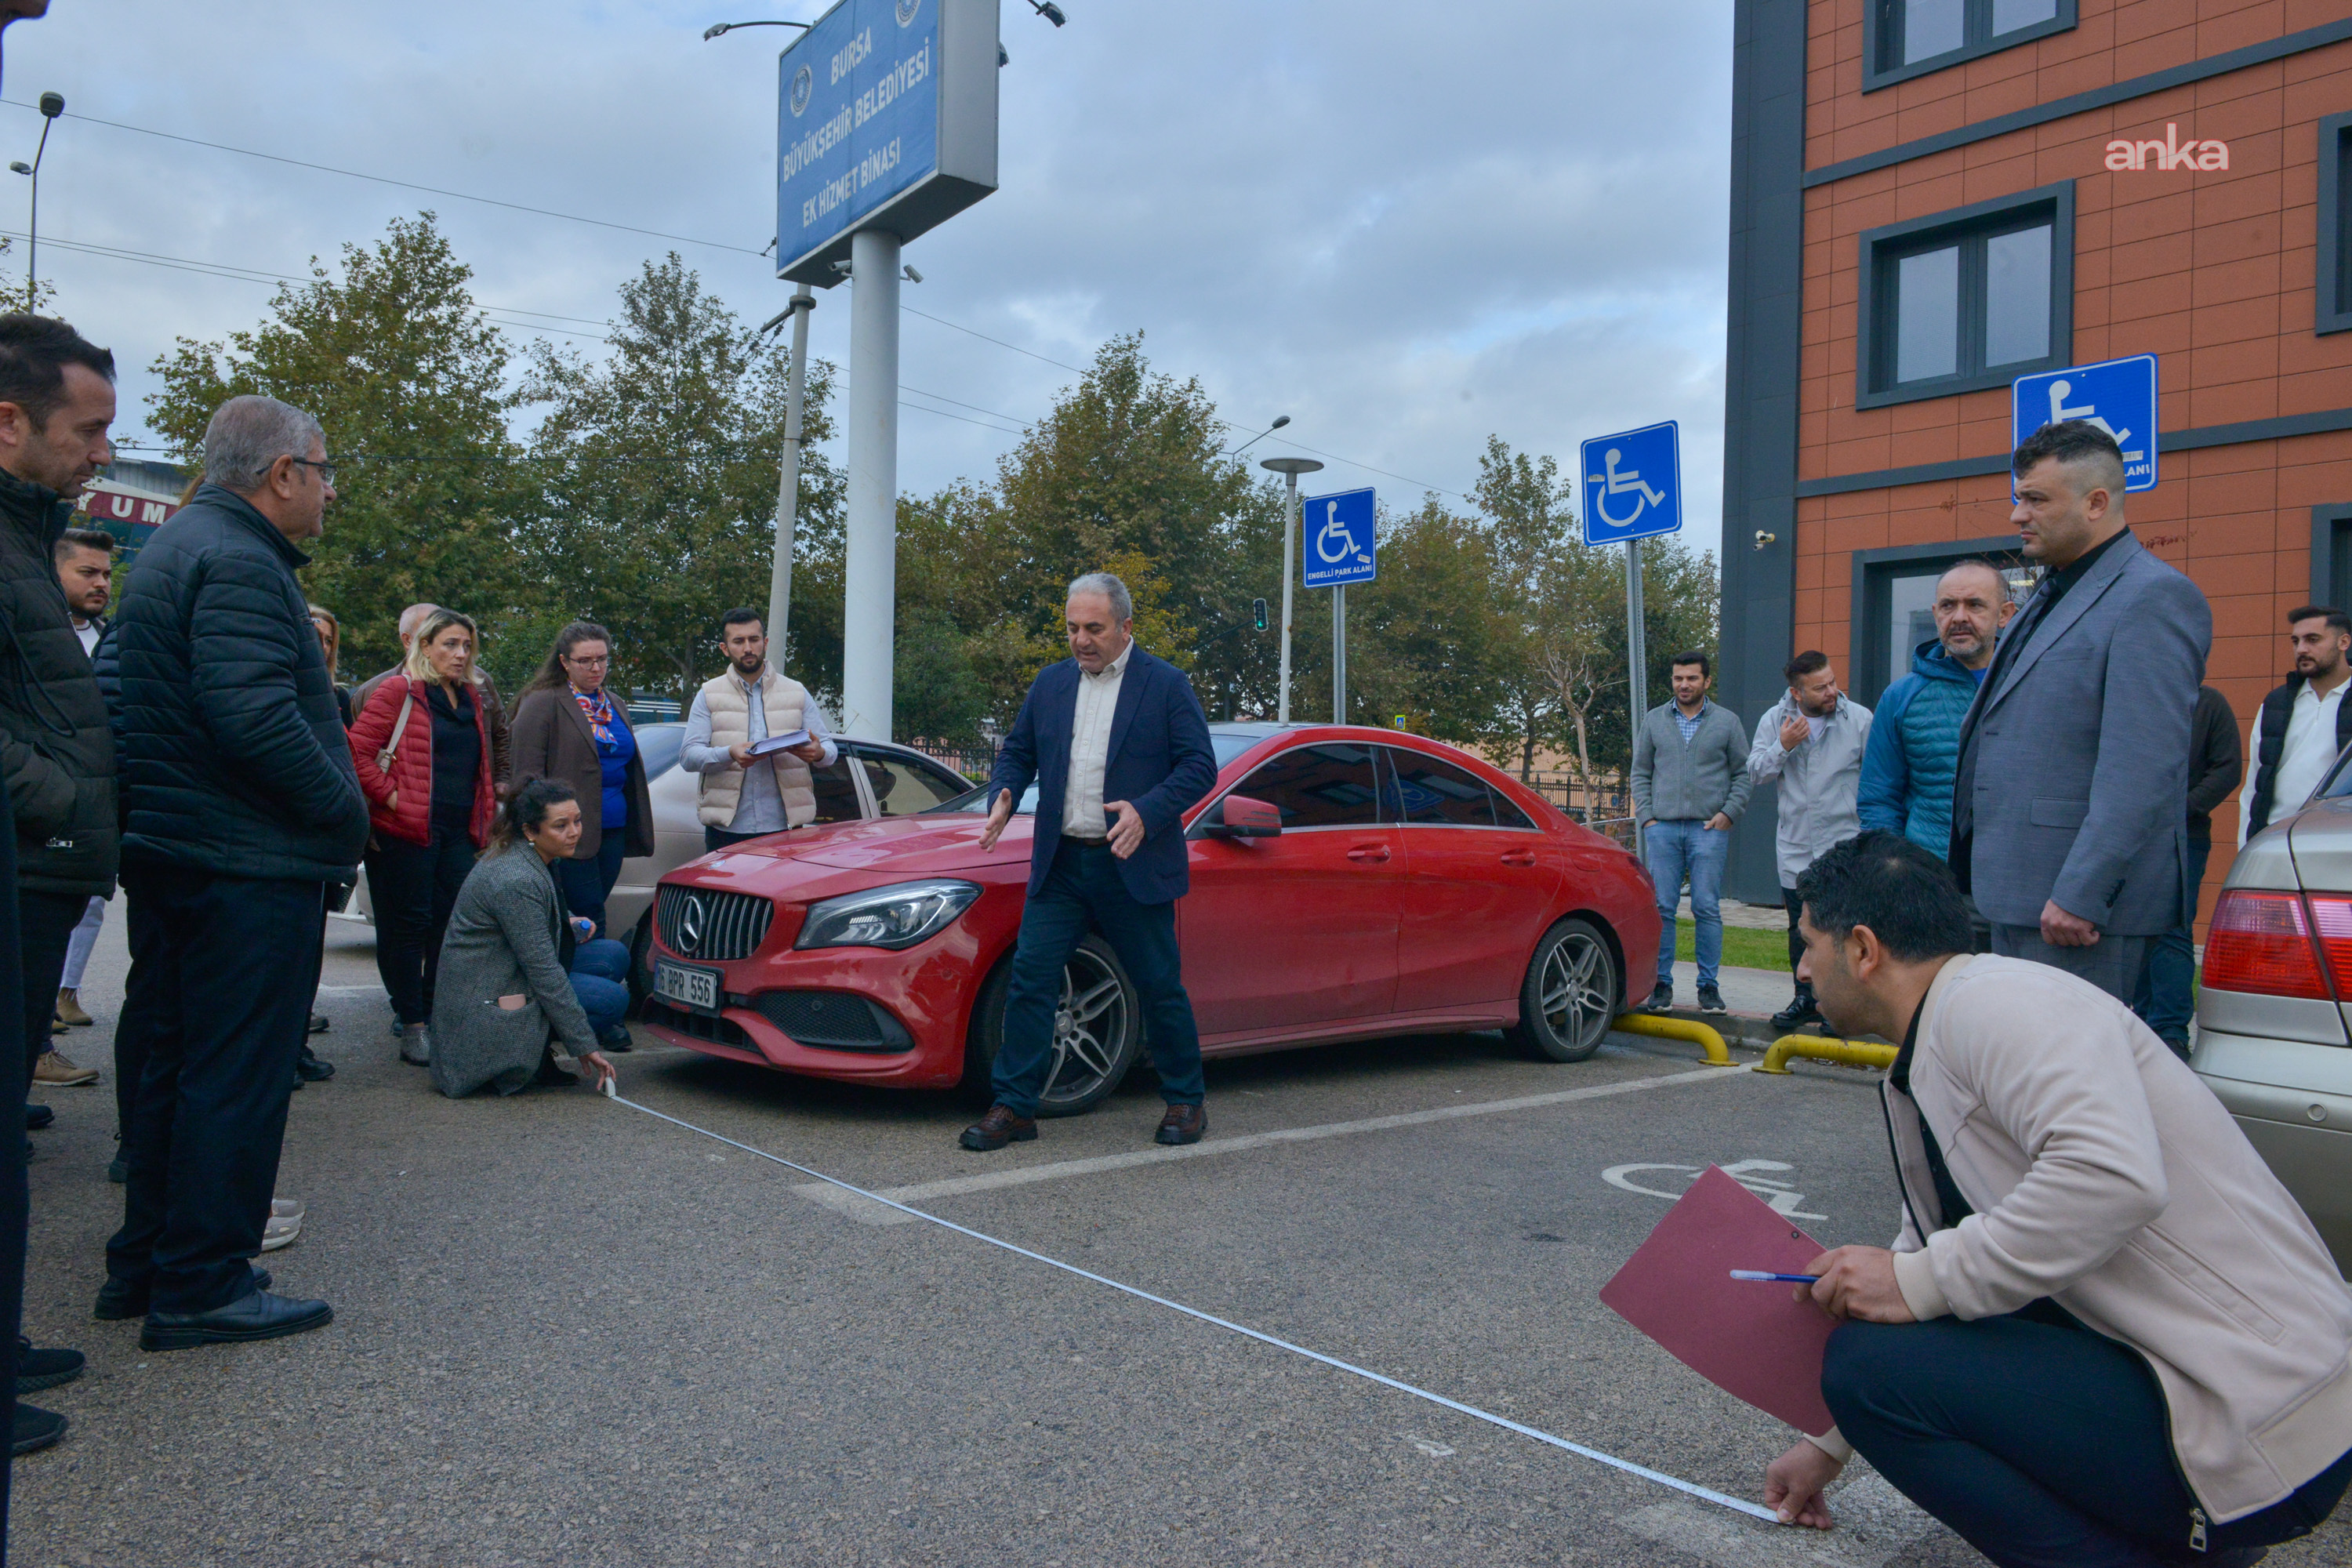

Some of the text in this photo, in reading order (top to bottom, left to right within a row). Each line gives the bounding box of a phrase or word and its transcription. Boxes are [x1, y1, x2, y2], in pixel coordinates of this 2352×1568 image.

[831, 26, 872, 86] BURSA
[783, 103, 852, 183] BÜYÜKŞEHİR
[855, 36, 929, 129] BELEDİYESİ
[803, 136, 900, 228] EK HİZMET BİNASI
[2125, 464, 2150, 477] ANI
[1308, 564, 1372, 579] ENGELLİ PARK ALANI
[669, 969, 684, 998] BPR
[691, 975, 710, 1003] 556
